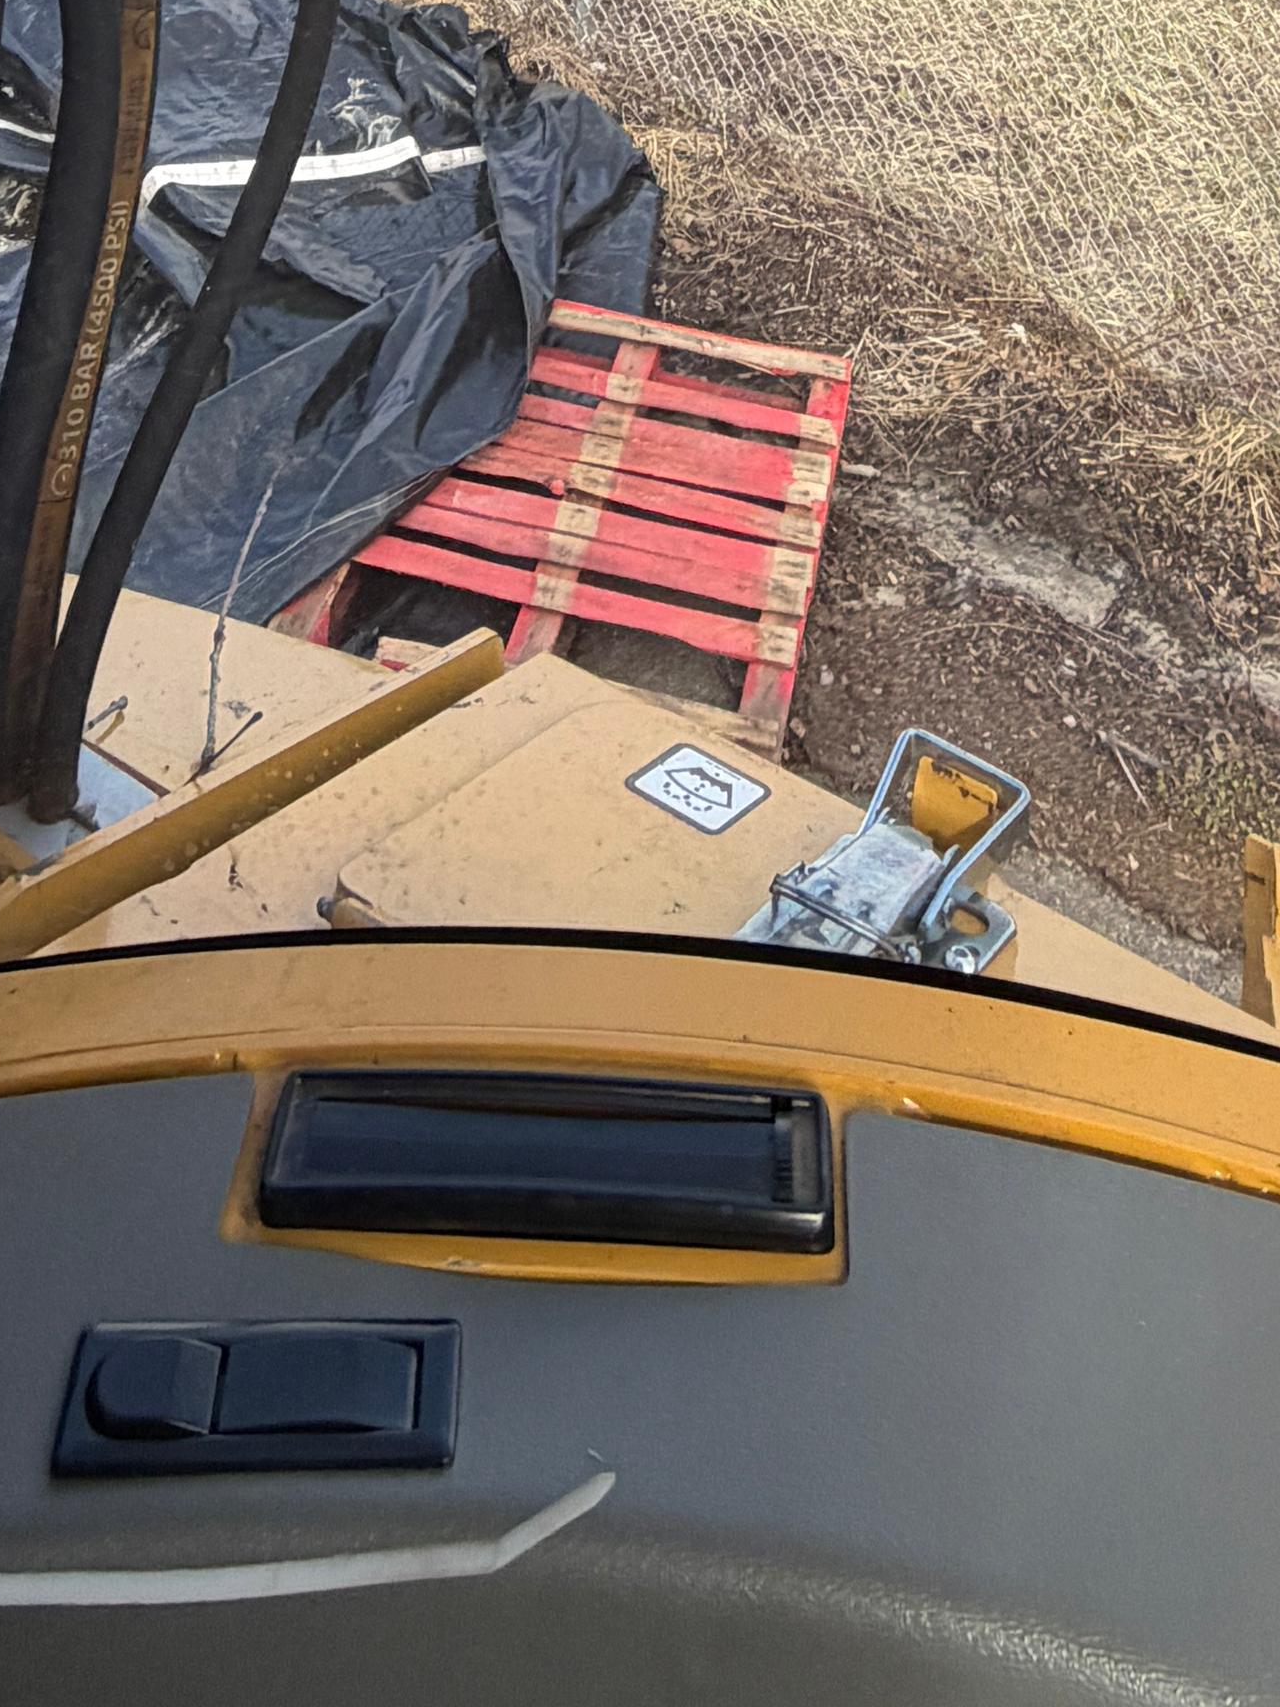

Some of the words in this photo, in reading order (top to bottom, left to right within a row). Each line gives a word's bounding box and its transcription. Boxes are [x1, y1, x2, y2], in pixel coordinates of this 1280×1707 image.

[104, 200, 130, 250] PSI)
[84, 257, 118, 334] (4500
[71, 341, 101, 401] BAR
[58, 407, 85, 460] 310
